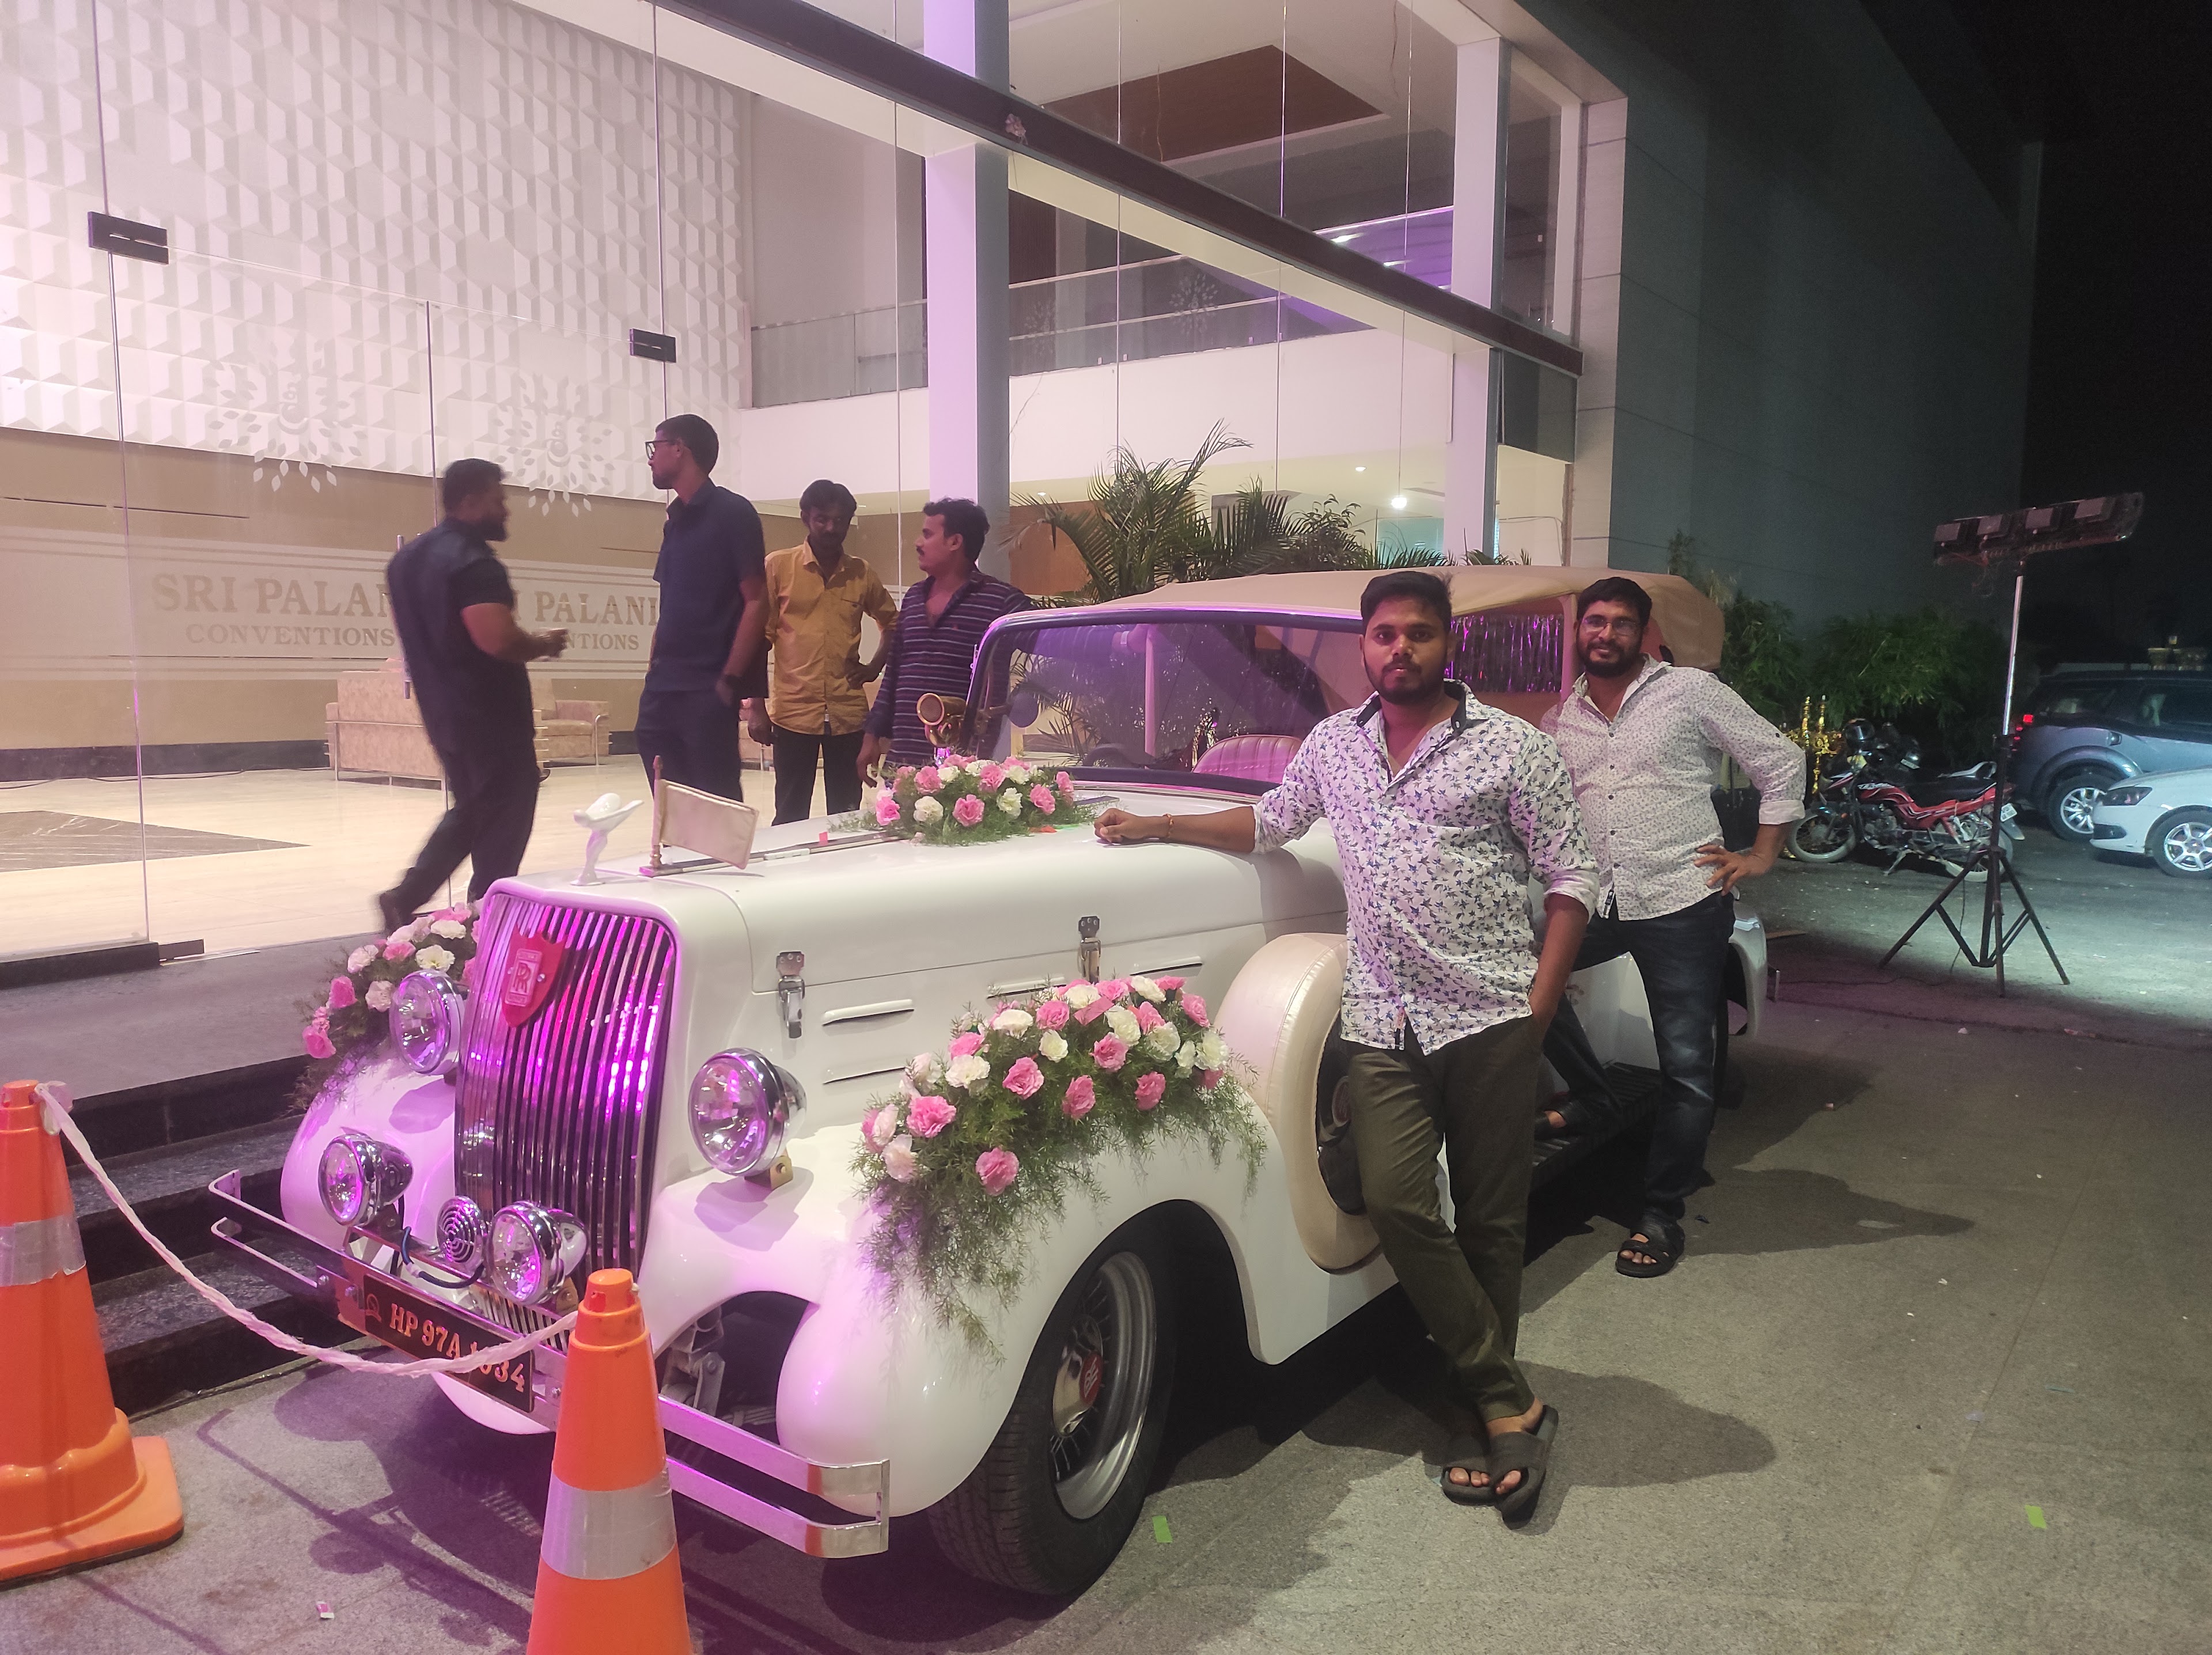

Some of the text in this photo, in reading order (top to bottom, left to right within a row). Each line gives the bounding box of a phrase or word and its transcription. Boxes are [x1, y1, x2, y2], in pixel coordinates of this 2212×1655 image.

[151, 572, 238, 613] SRI
[533, 590, 658, 626] PALANI
[185, 624, 396, 646] CONVENTIONS
[389, 1303, 418, 1338] HP
[421, 1319, 460, 1359] 97A
